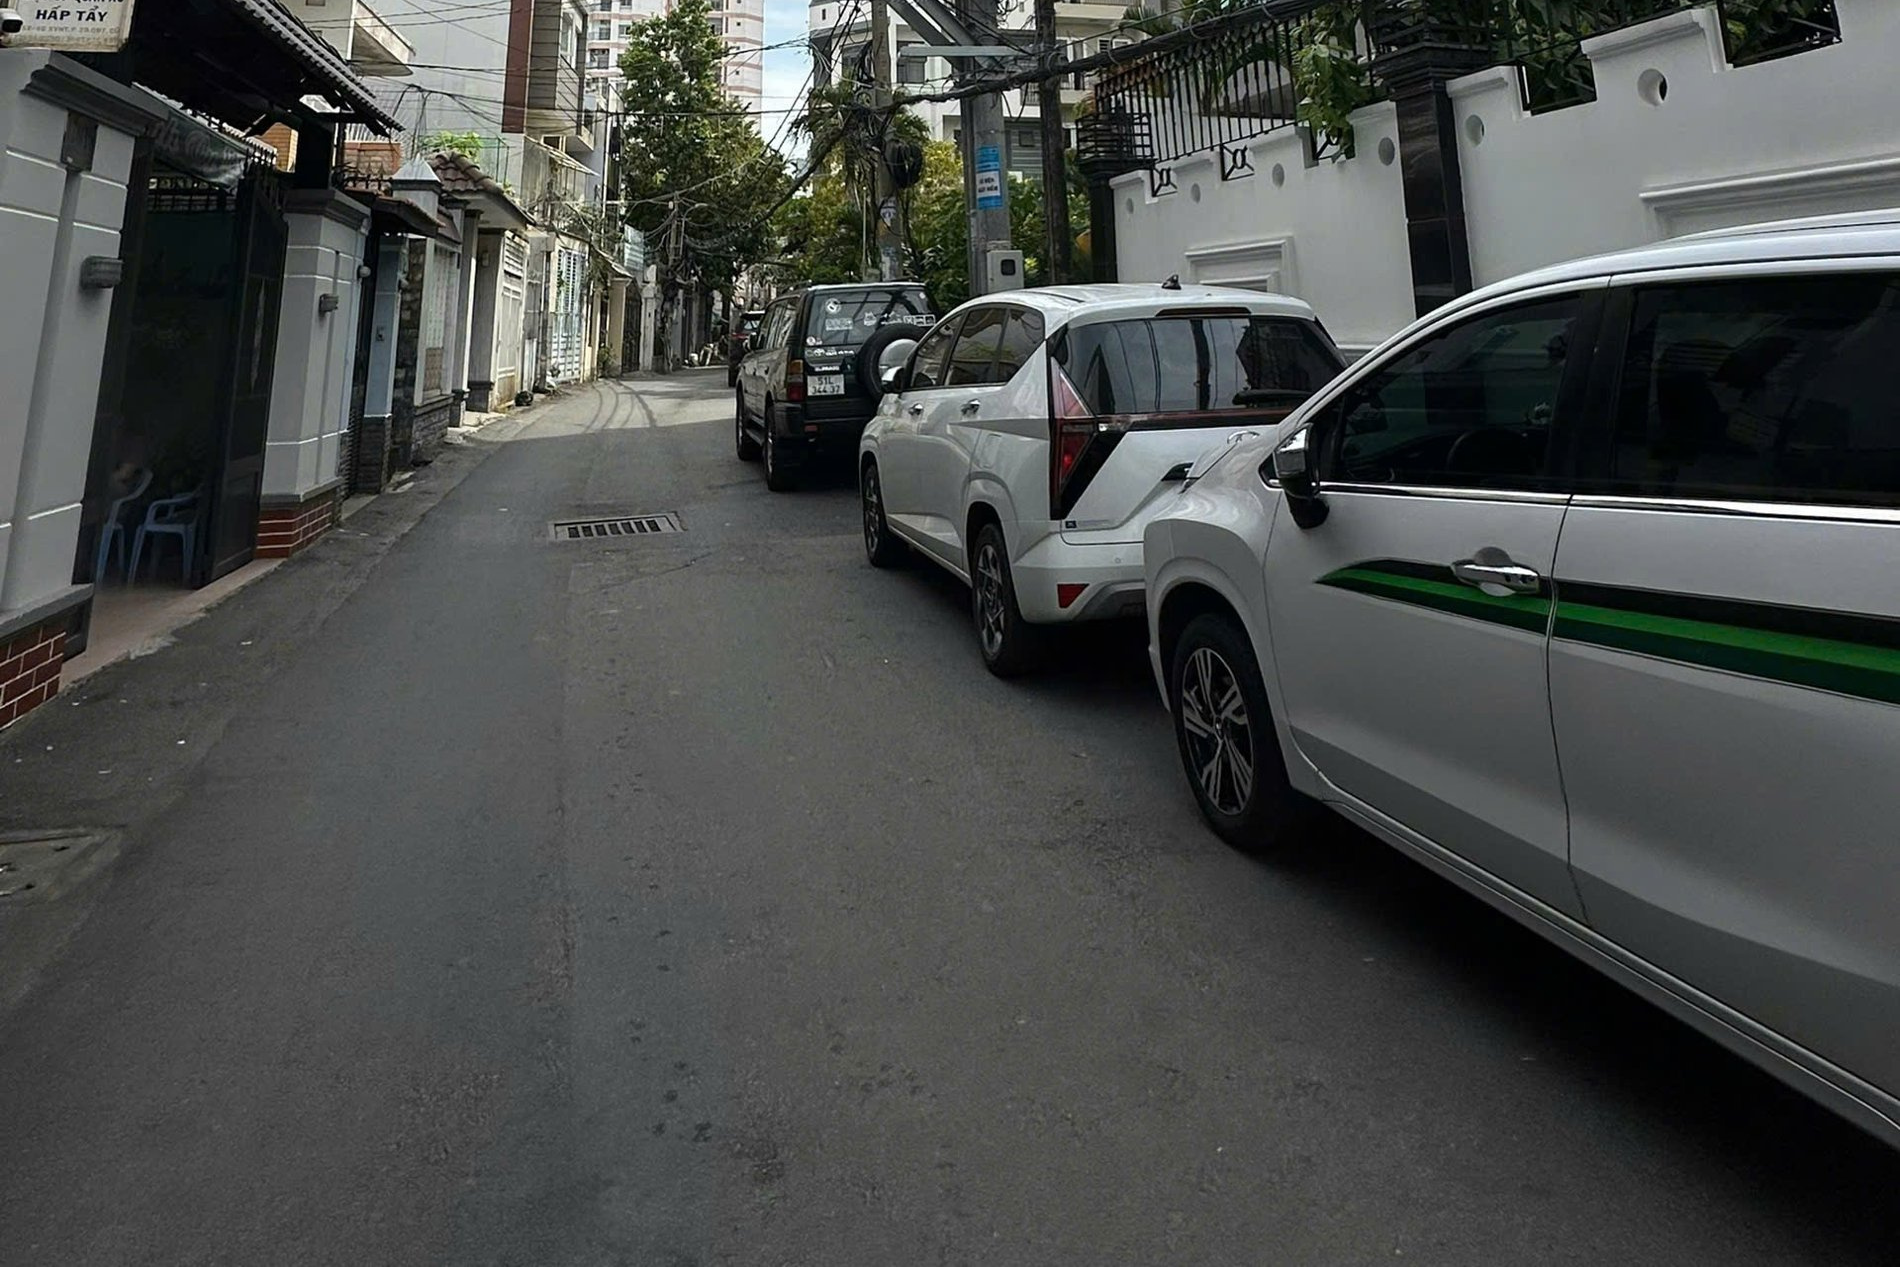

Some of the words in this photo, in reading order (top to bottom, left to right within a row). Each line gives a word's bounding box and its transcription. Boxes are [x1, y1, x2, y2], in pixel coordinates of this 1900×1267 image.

[35, 6, 71, 20] HẤP
[76, 6, 108, 22] TẨY
[818, 377, 833, 385] 51L
